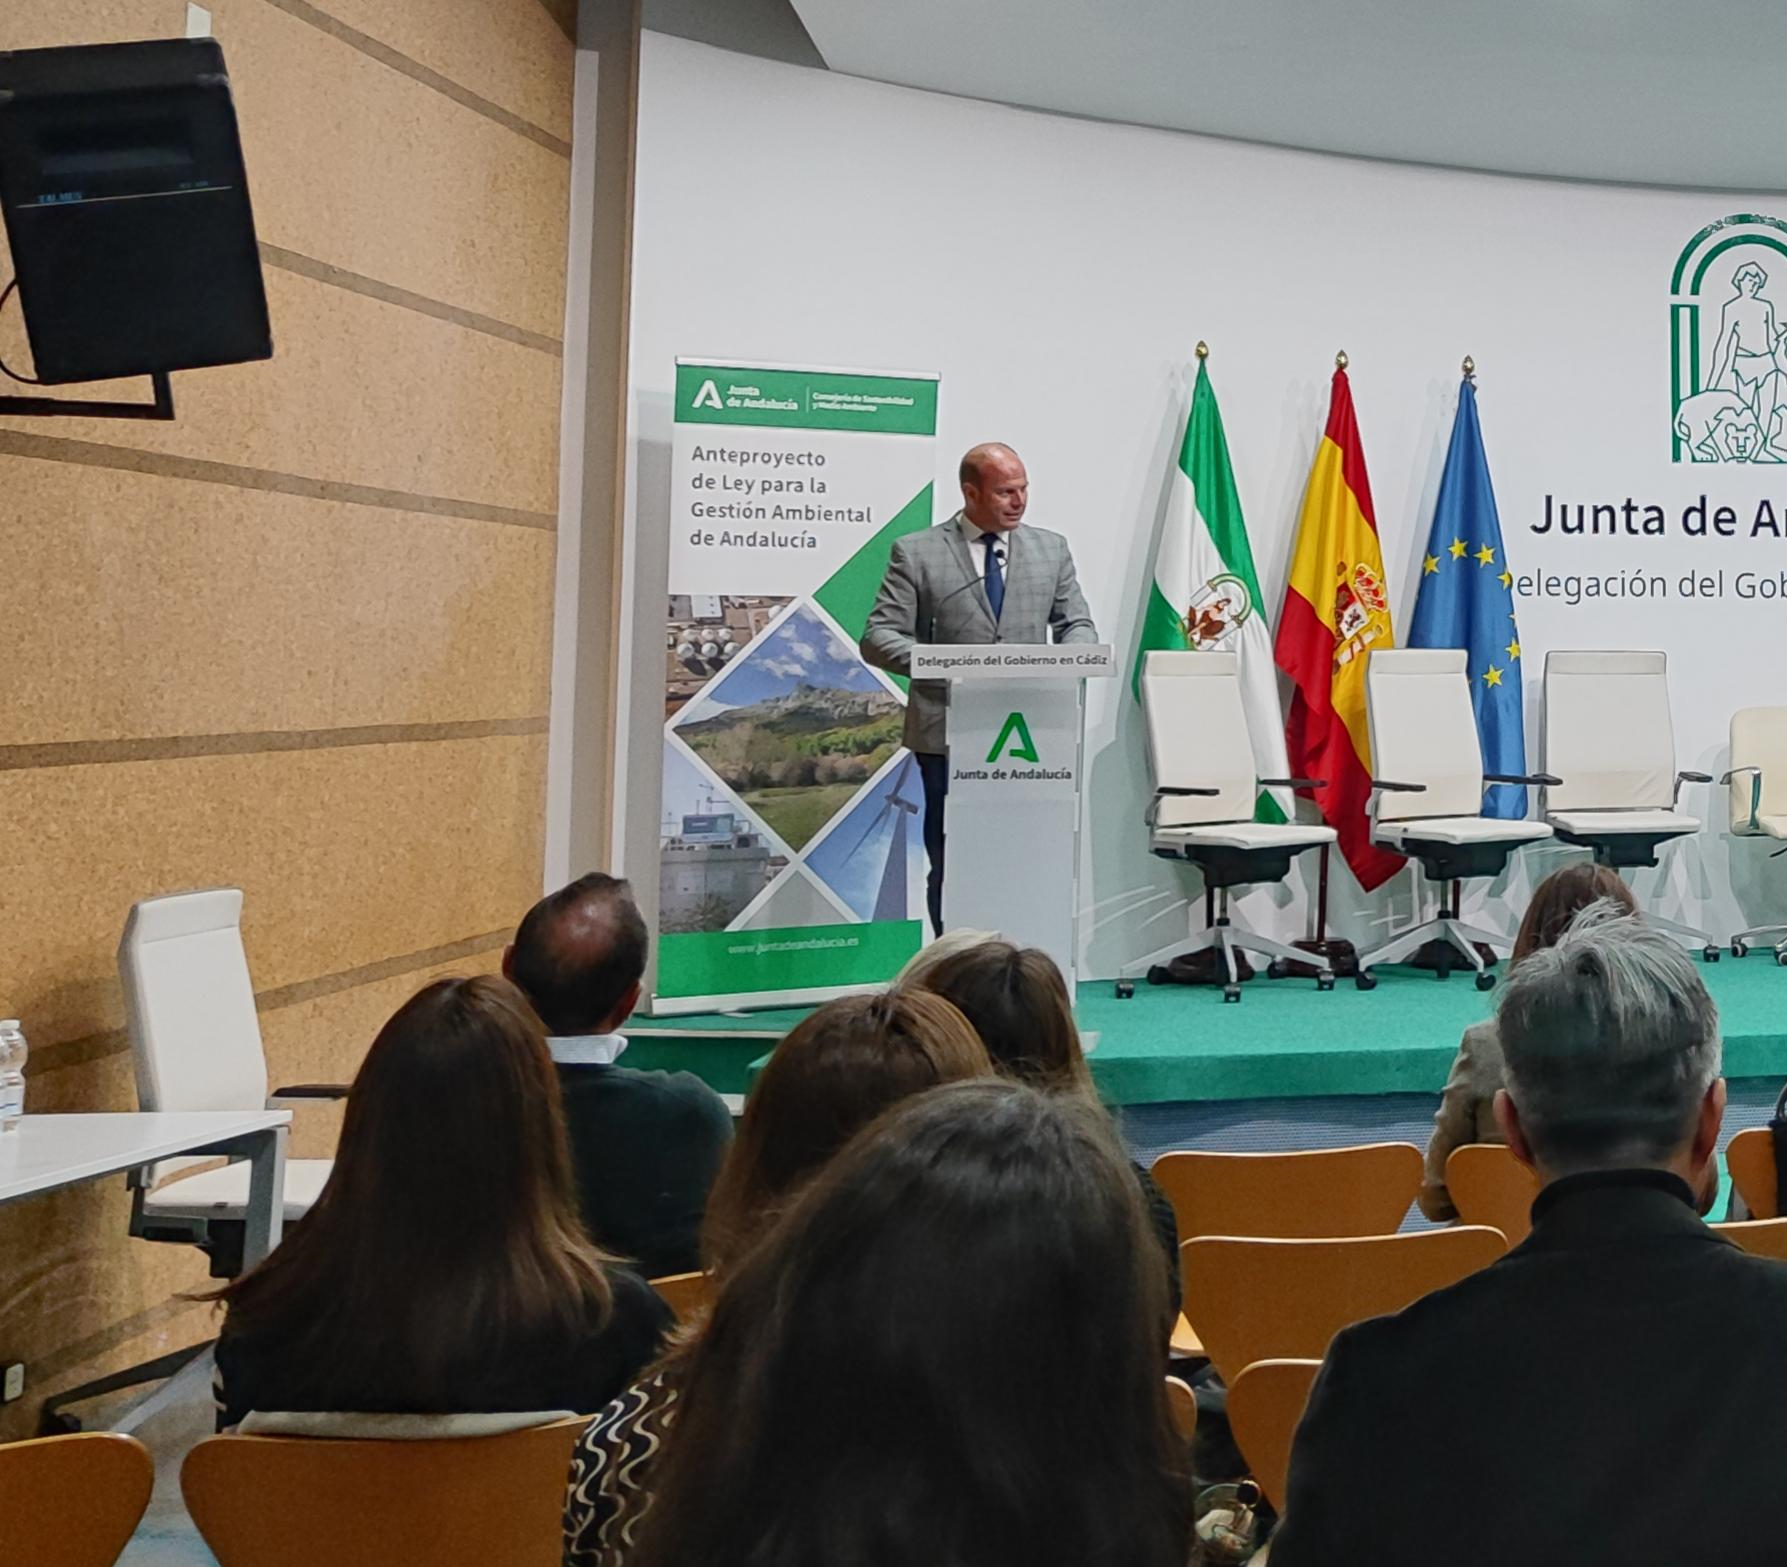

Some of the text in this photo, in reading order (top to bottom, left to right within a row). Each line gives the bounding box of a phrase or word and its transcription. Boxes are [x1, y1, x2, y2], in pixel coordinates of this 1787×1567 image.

[692, 446, 825, 468] Anteproyecto
[692, 473, 826, 495] de Ley para la
[691, 501, 871, 523] Gestión Ambiental
[1530, 495, 1664, 535] Junta
[1682, 495, 1736, 536] de
[690, 529, 816, 548] de Andalucía
[1510, 568, 1666, 605] elegación
[1679, 570, 1722, 597] del
[918, 654, 1107, 668] Delegación del Gobierno en Cádiz
[953, 768, 1071, 779] Junta de Andalucía
